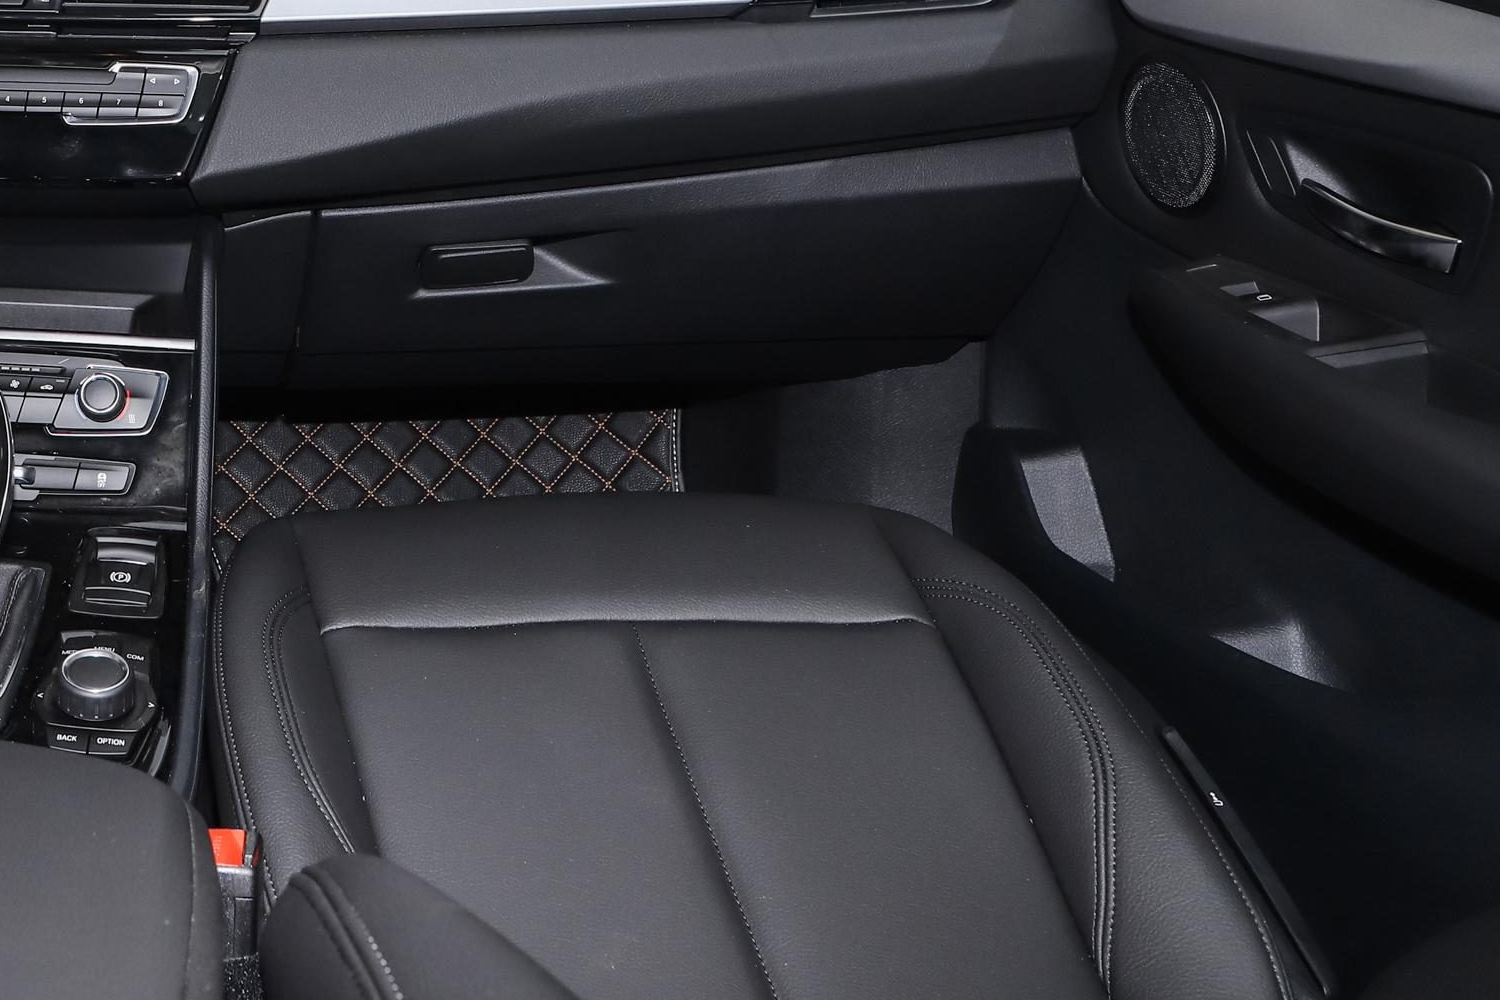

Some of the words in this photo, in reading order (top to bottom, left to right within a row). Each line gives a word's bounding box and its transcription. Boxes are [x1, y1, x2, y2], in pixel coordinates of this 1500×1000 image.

[126, 653, 144, 661] COM
[56, 734, 77, 742] BACK
[97, 737, 125, 746] OPTION
